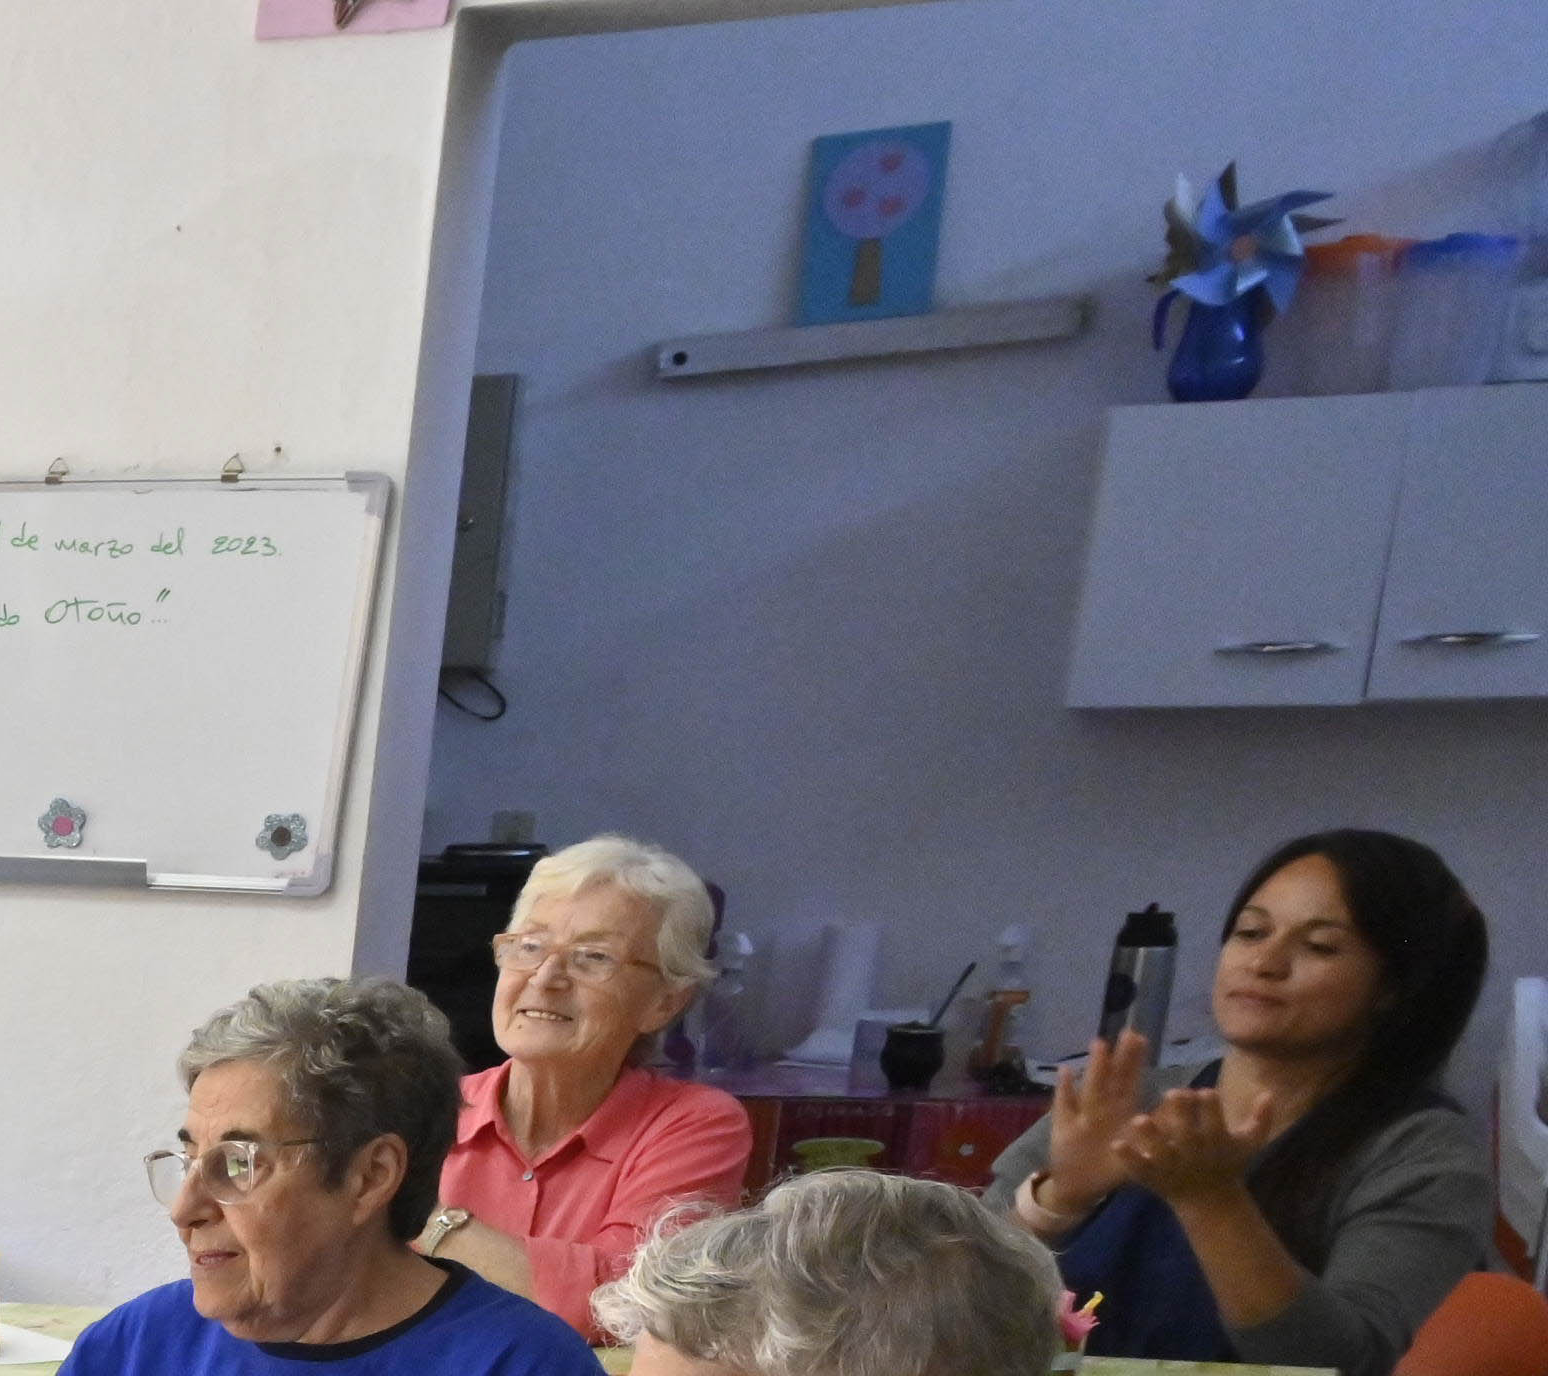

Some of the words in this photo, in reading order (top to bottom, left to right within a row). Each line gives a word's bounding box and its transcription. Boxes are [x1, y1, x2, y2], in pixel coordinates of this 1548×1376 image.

[11, 522, 39, 551] de
[54, 539, 133, 558] marzo
[150, 527, 184, 555] del
